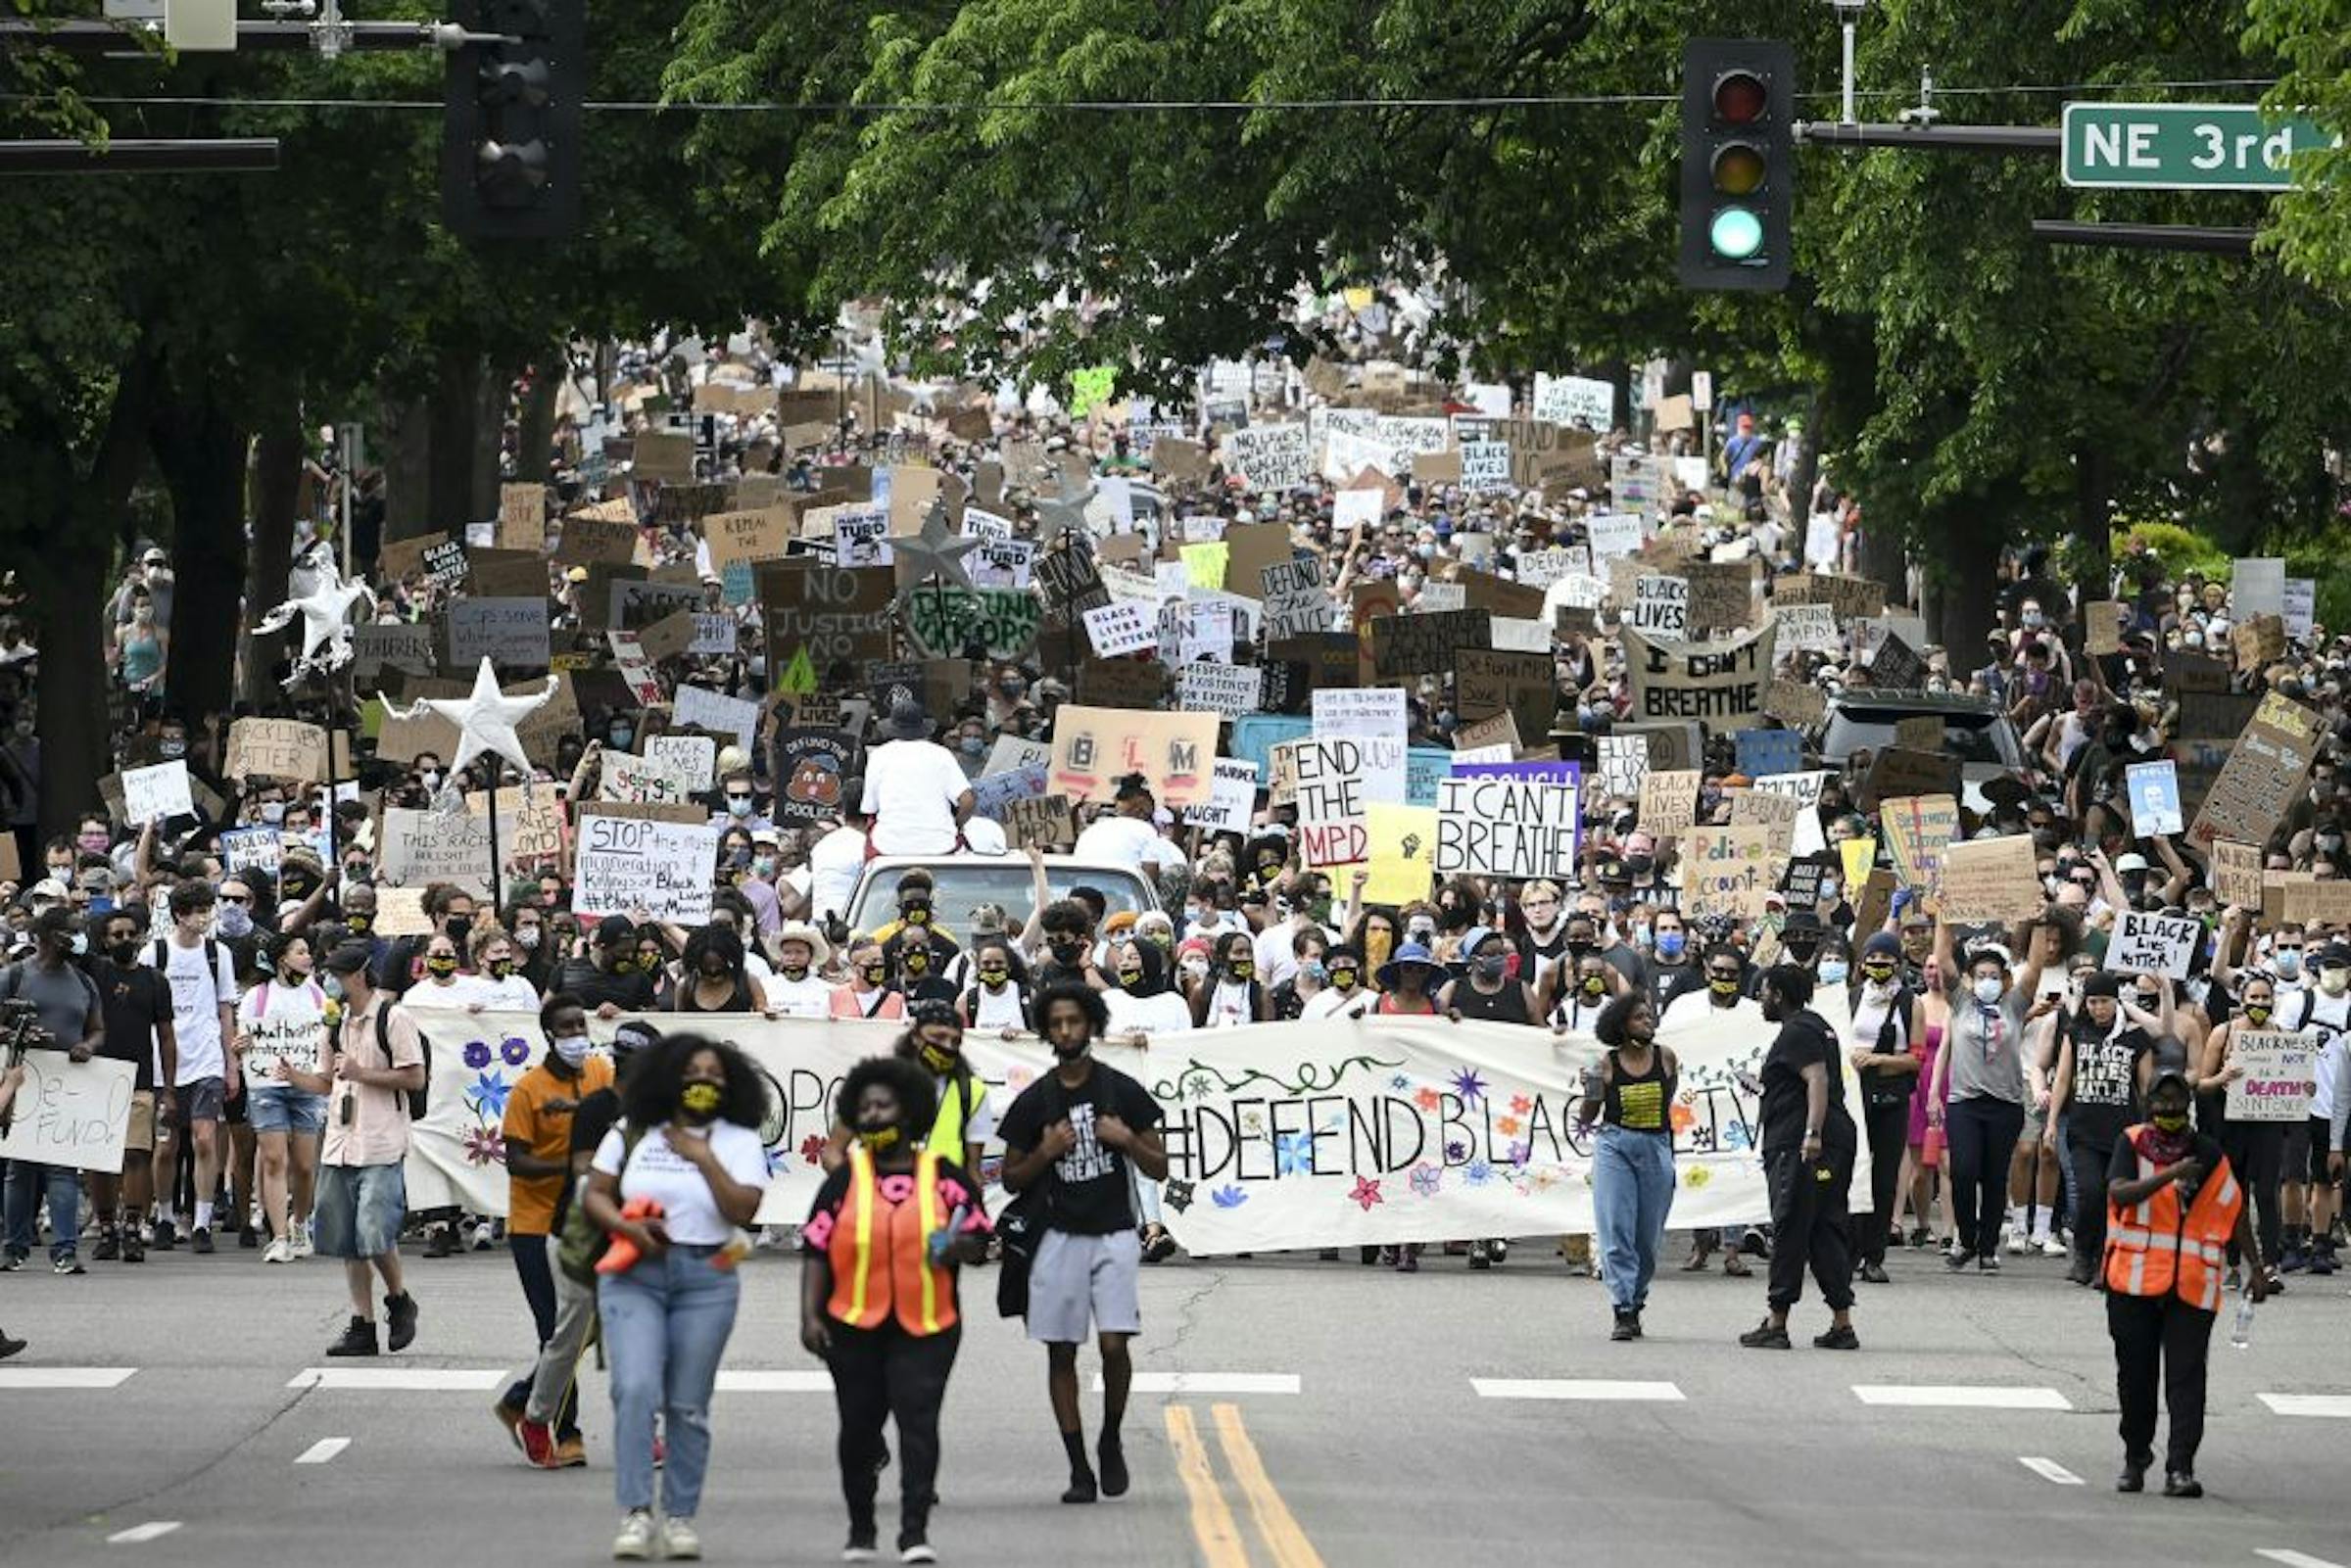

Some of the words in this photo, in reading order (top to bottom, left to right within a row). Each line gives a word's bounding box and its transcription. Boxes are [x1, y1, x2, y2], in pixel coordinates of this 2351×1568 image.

[2084, 122, 2161, 167] NE
[2190, 123, 2293, 169] 3rd
[1463, 447, 1508, 460] BLACK
[1462, 460, 1505, 474] LIVES
[840, 523, 885, 538] TURD
[423, 541, 460, 561] BLACK
[981, 549, 1027, 565] TURD
[1524, 549, 1585, 571] DEFUND
[804, 570, 858, 603] NO
[1636, 579, 1688, 600] BLACK
[1092, 606, 1135, 623] BLACK
[1635, 601, 1684, 630] LIVES
[809, 636, 852, 657] NO
[1646, 644, 1667, 672] I
[1687, 641, 1759, 678] CAN'T
[1186, 665, 1238, 678] RESPECT
[1202, 692, 1245, 704] EXPECT
[1645, 684, 1759, 716] BREATHE
[653, 736, 705, 756] BLACK
[1296, 740, 1360, 780] END
[1648, 777, 1695, 794] BLACK
[1299, 779, 1364, 820] THE
[1439, 783, 1464, 813] I
[1473, 783, 1575, 824] CAN'T
[1646, 795, 1691, 814] LIVES
[403, 833, 440, 847] THIS
[591, 820, 653, 849] STOP
[1304, 825, 1367, 862] MPD
[1437, 819, 1573, 879] BREATHE
[2123, 916, 2195, 944] BLACK
[2239, 1034, 2317, 1052] BLACKNESS
[2245, 1078, 2302, 1096] DEATH
[1157, 1095, 1425, 1181] #DEFEND
[1440, 1091, 1594, 1167] BLAC
